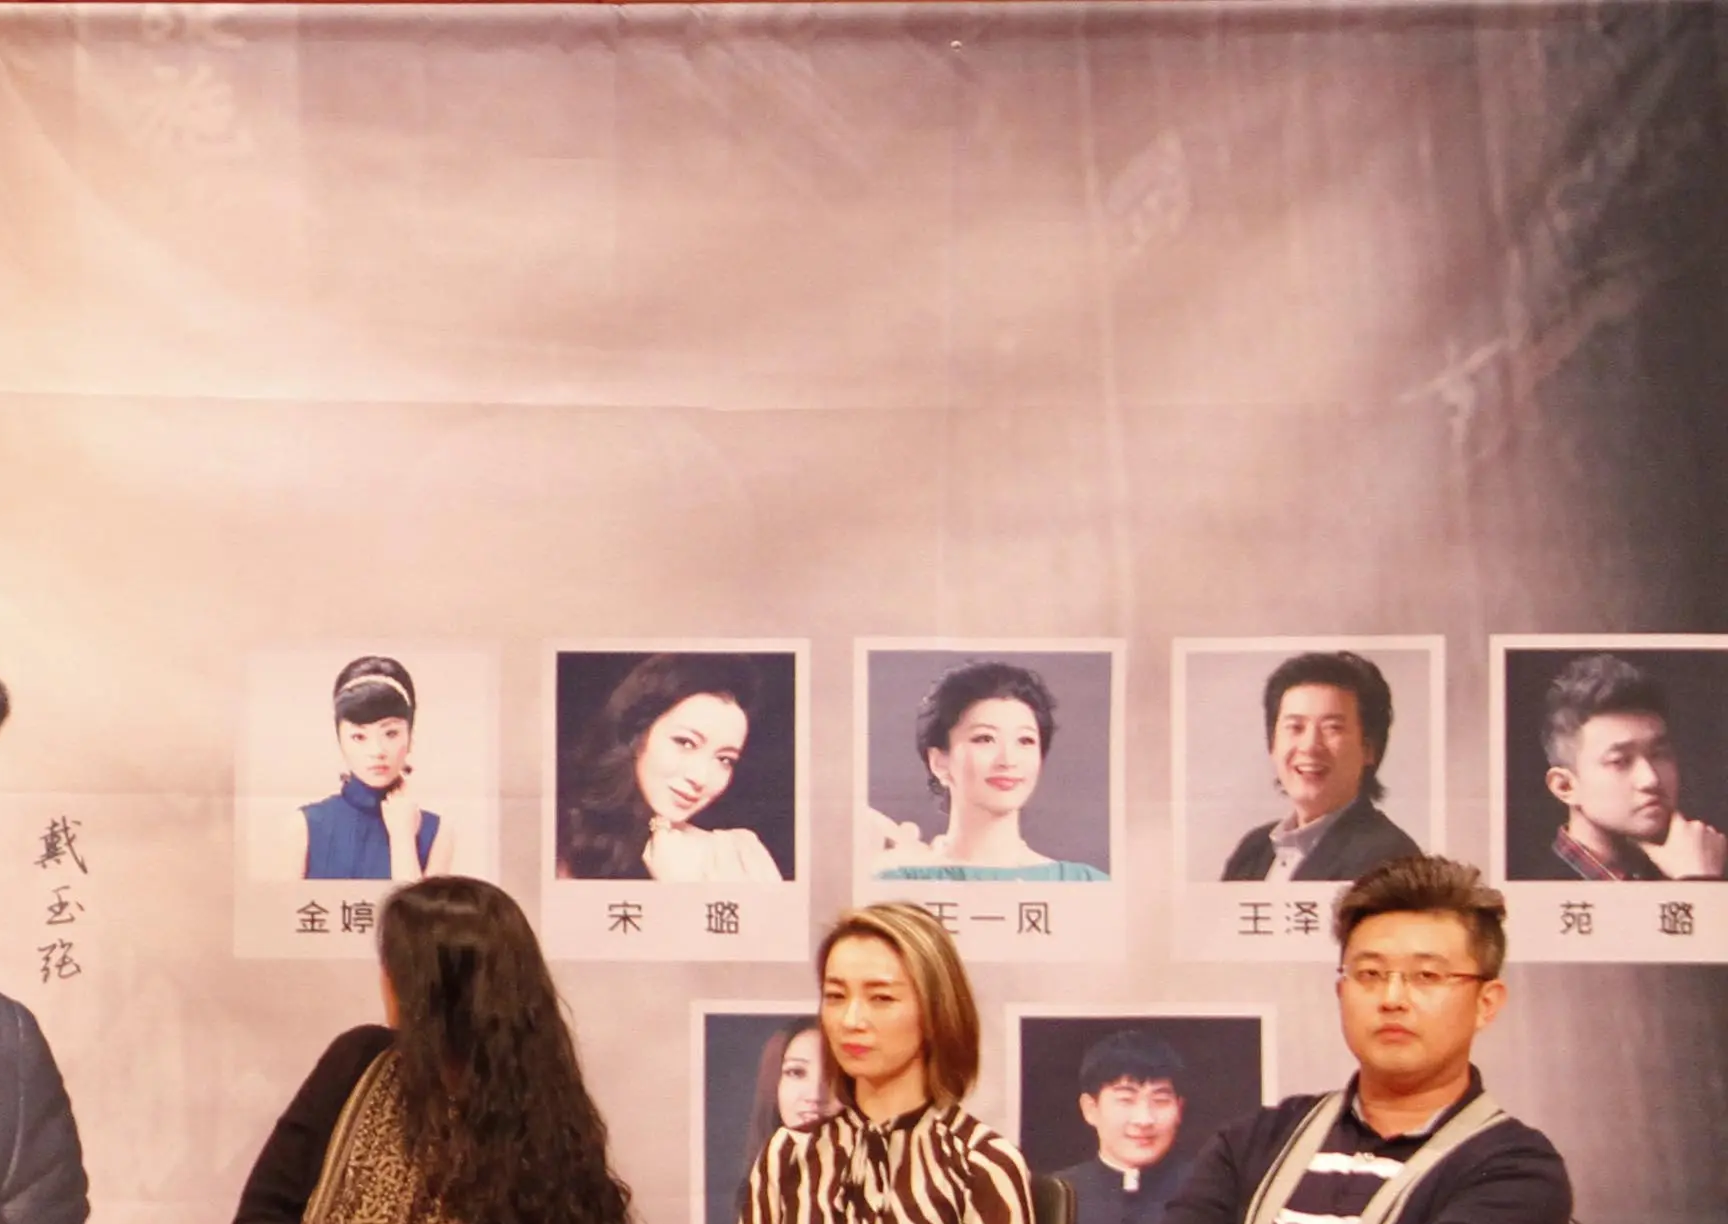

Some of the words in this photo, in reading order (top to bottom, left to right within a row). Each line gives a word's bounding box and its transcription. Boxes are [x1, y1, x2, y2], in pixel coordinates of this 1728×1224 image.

[296, 900, 375, 935] 金婷
[608, 901, 741, 935] 宋璐
[1238, 901, 1320, 935] 王泽
[1559, 901, 1695, 935] 苑璐
